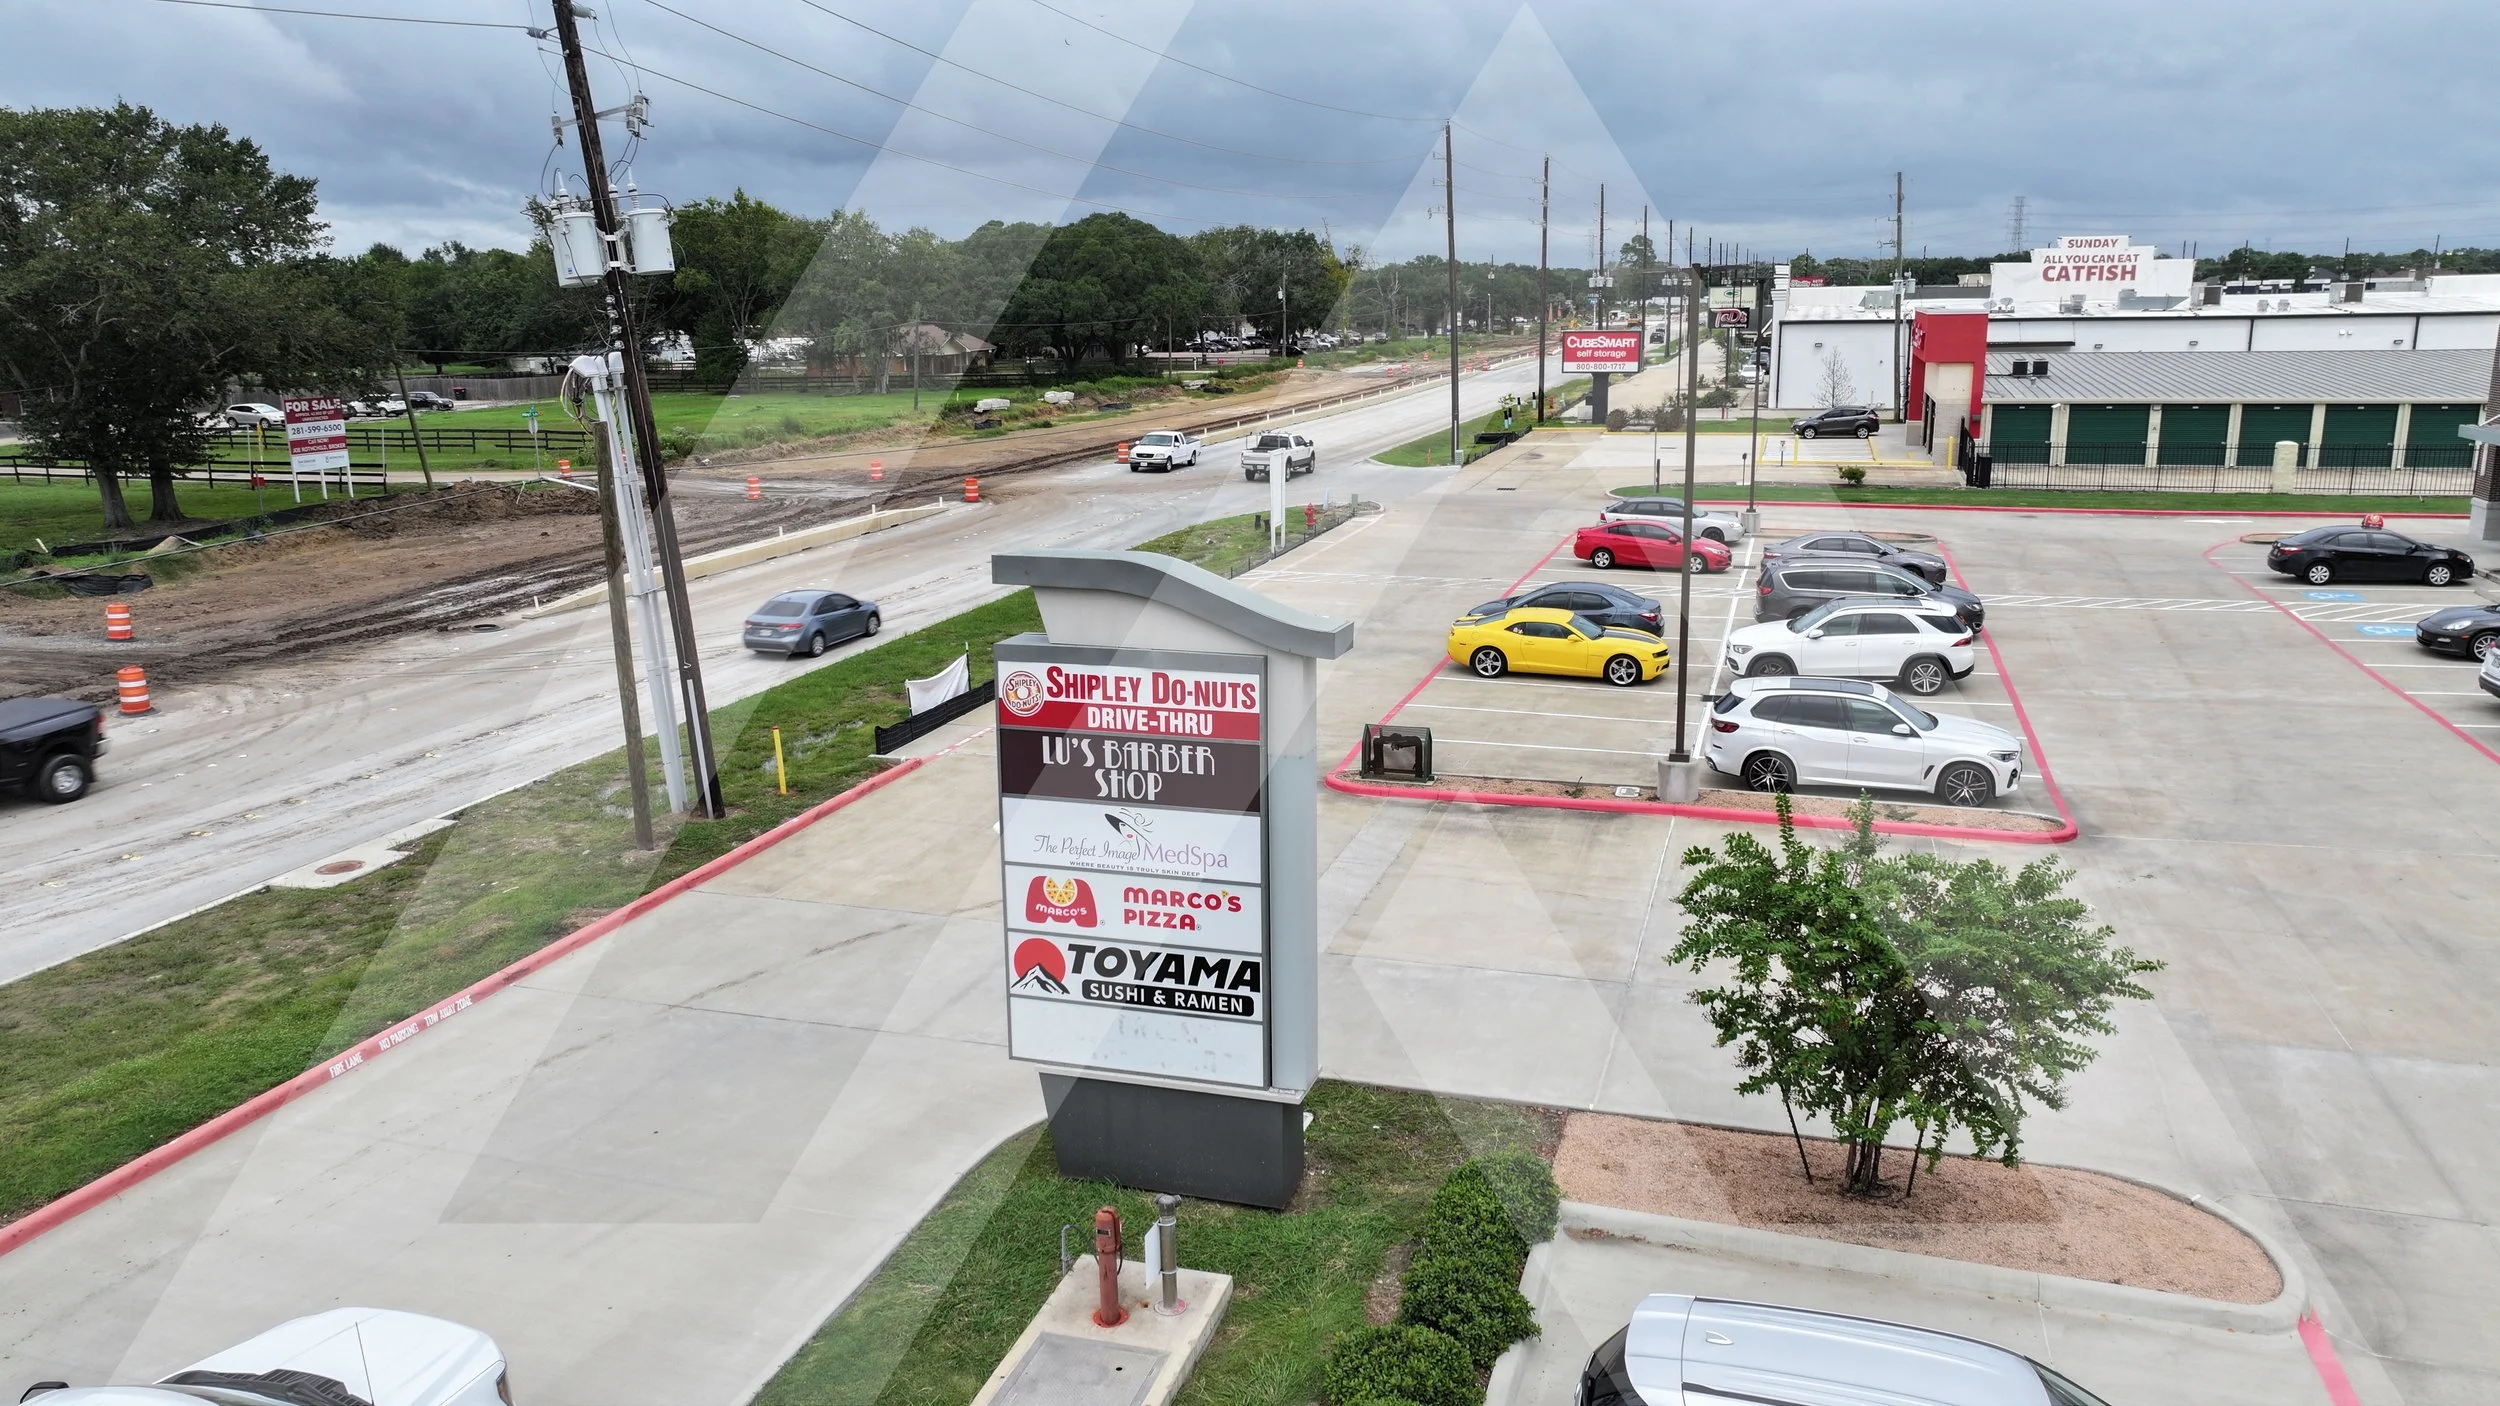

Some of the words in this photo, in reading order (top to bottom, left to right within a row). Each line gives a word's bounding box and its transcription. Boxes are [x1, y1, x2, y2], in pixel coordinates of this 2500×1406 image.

[2067, 238, 2119, 249] SUNDAY
[2043, 254, 2064, 264] ALL
[2066, 255, 2089, 264] YOU
[2091, 254, 2115, 263] CAN
[2117, 253, 2140, 263] EAT
[2042, 265, 2137, 282] CATFISH
[1576, 349, 1592, 357] self
[1593, 350, 1627, 359] storage
[285, 401, 309, 412] FOR
[311, 398, 340, 410] SALE
[292, 424, 342, 435] 281-599-6500
[1007, 678, 1037, 691] SHIPLEY
[1046, 665, 1142, 704] SHIPLEY
[1152, 671, 1257, 710] DO-NUTS
[1087, 706, 1213, 736] DRIVE-THRU
[1041, 735, 1095, 768] LU'S
[1103, 740, 1215, 776] BARBER
[1094, 768, 1162, 801] SHOP
[1033, 834, 1058, 854] The
[1061, 836, 1097, 861] Perfect
[1098, 839, 1139, 864] Image
[1143, 843, 1228, 873] MedSpa
[1035, 903, 1087, 918] MARCO'S
[1123, 886, 1242, 913] MARCO'S
[1124, 908, 1196, 932] PIZZA
[1067, 943, 1262, 994] TOYAMA
[1090, 983, 1146, 1004] SUSHI
[1153, 989, 1167, 1005] &
[1174, 992, 1244, 1013] RAMEN
[329, 1061, 346, 1078] FIRE
[345, 1052, 364, 1070] LANE
[378, 1037, 391, 1051] NO
[389, 1022, 420, 1046] PARKING
[424, 1012, 439, 1027] TOW
[439, 1003, 456, 1020] AWAY
[455, 995, 473, 1011] ZONE
